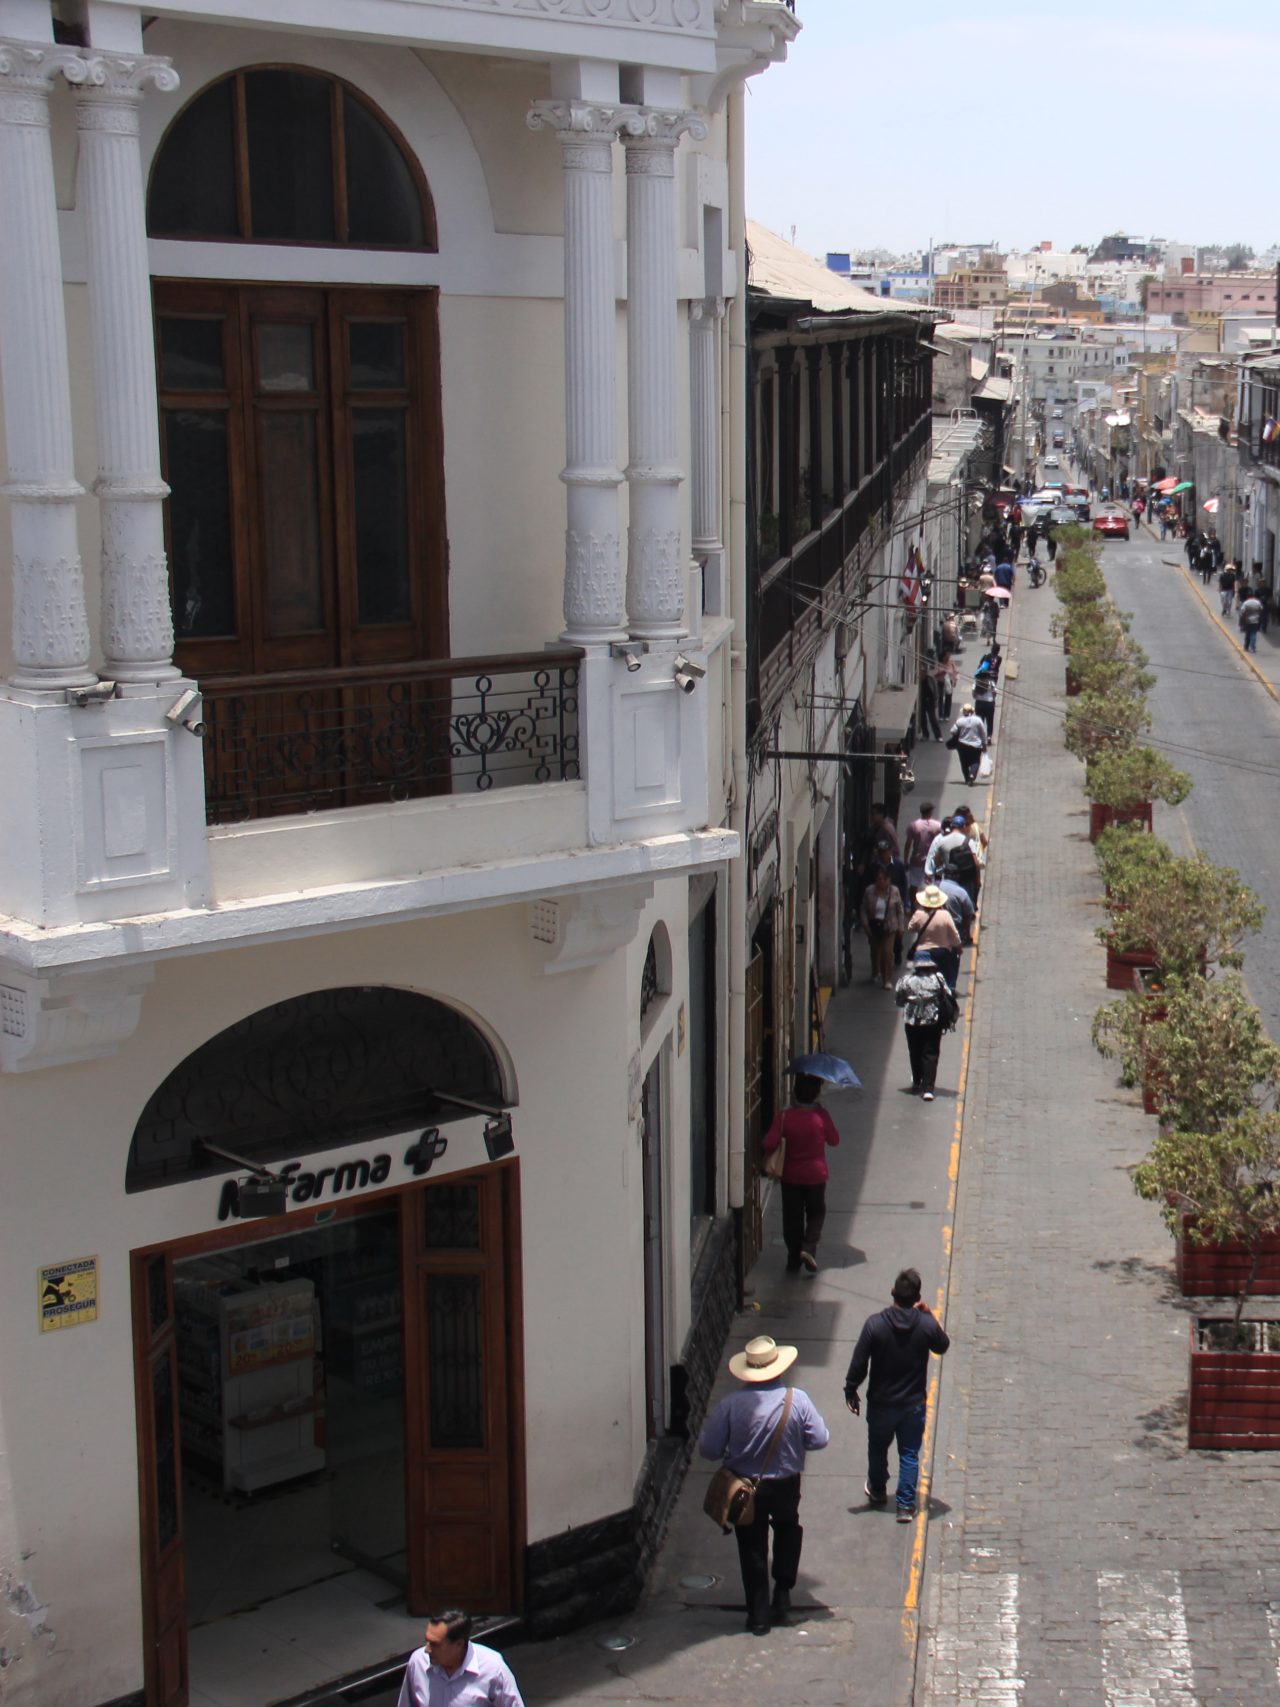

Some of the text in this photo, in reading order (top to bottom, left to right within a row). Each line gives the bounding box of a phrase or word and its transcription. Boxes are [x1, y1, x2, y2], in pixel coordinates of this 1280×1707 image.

[218, 1154, 392, 1221] Mfarma
[42, 1259, 95, 1277] CONECTADA
[43, 1299, 96, 1318] PROSEGUR
